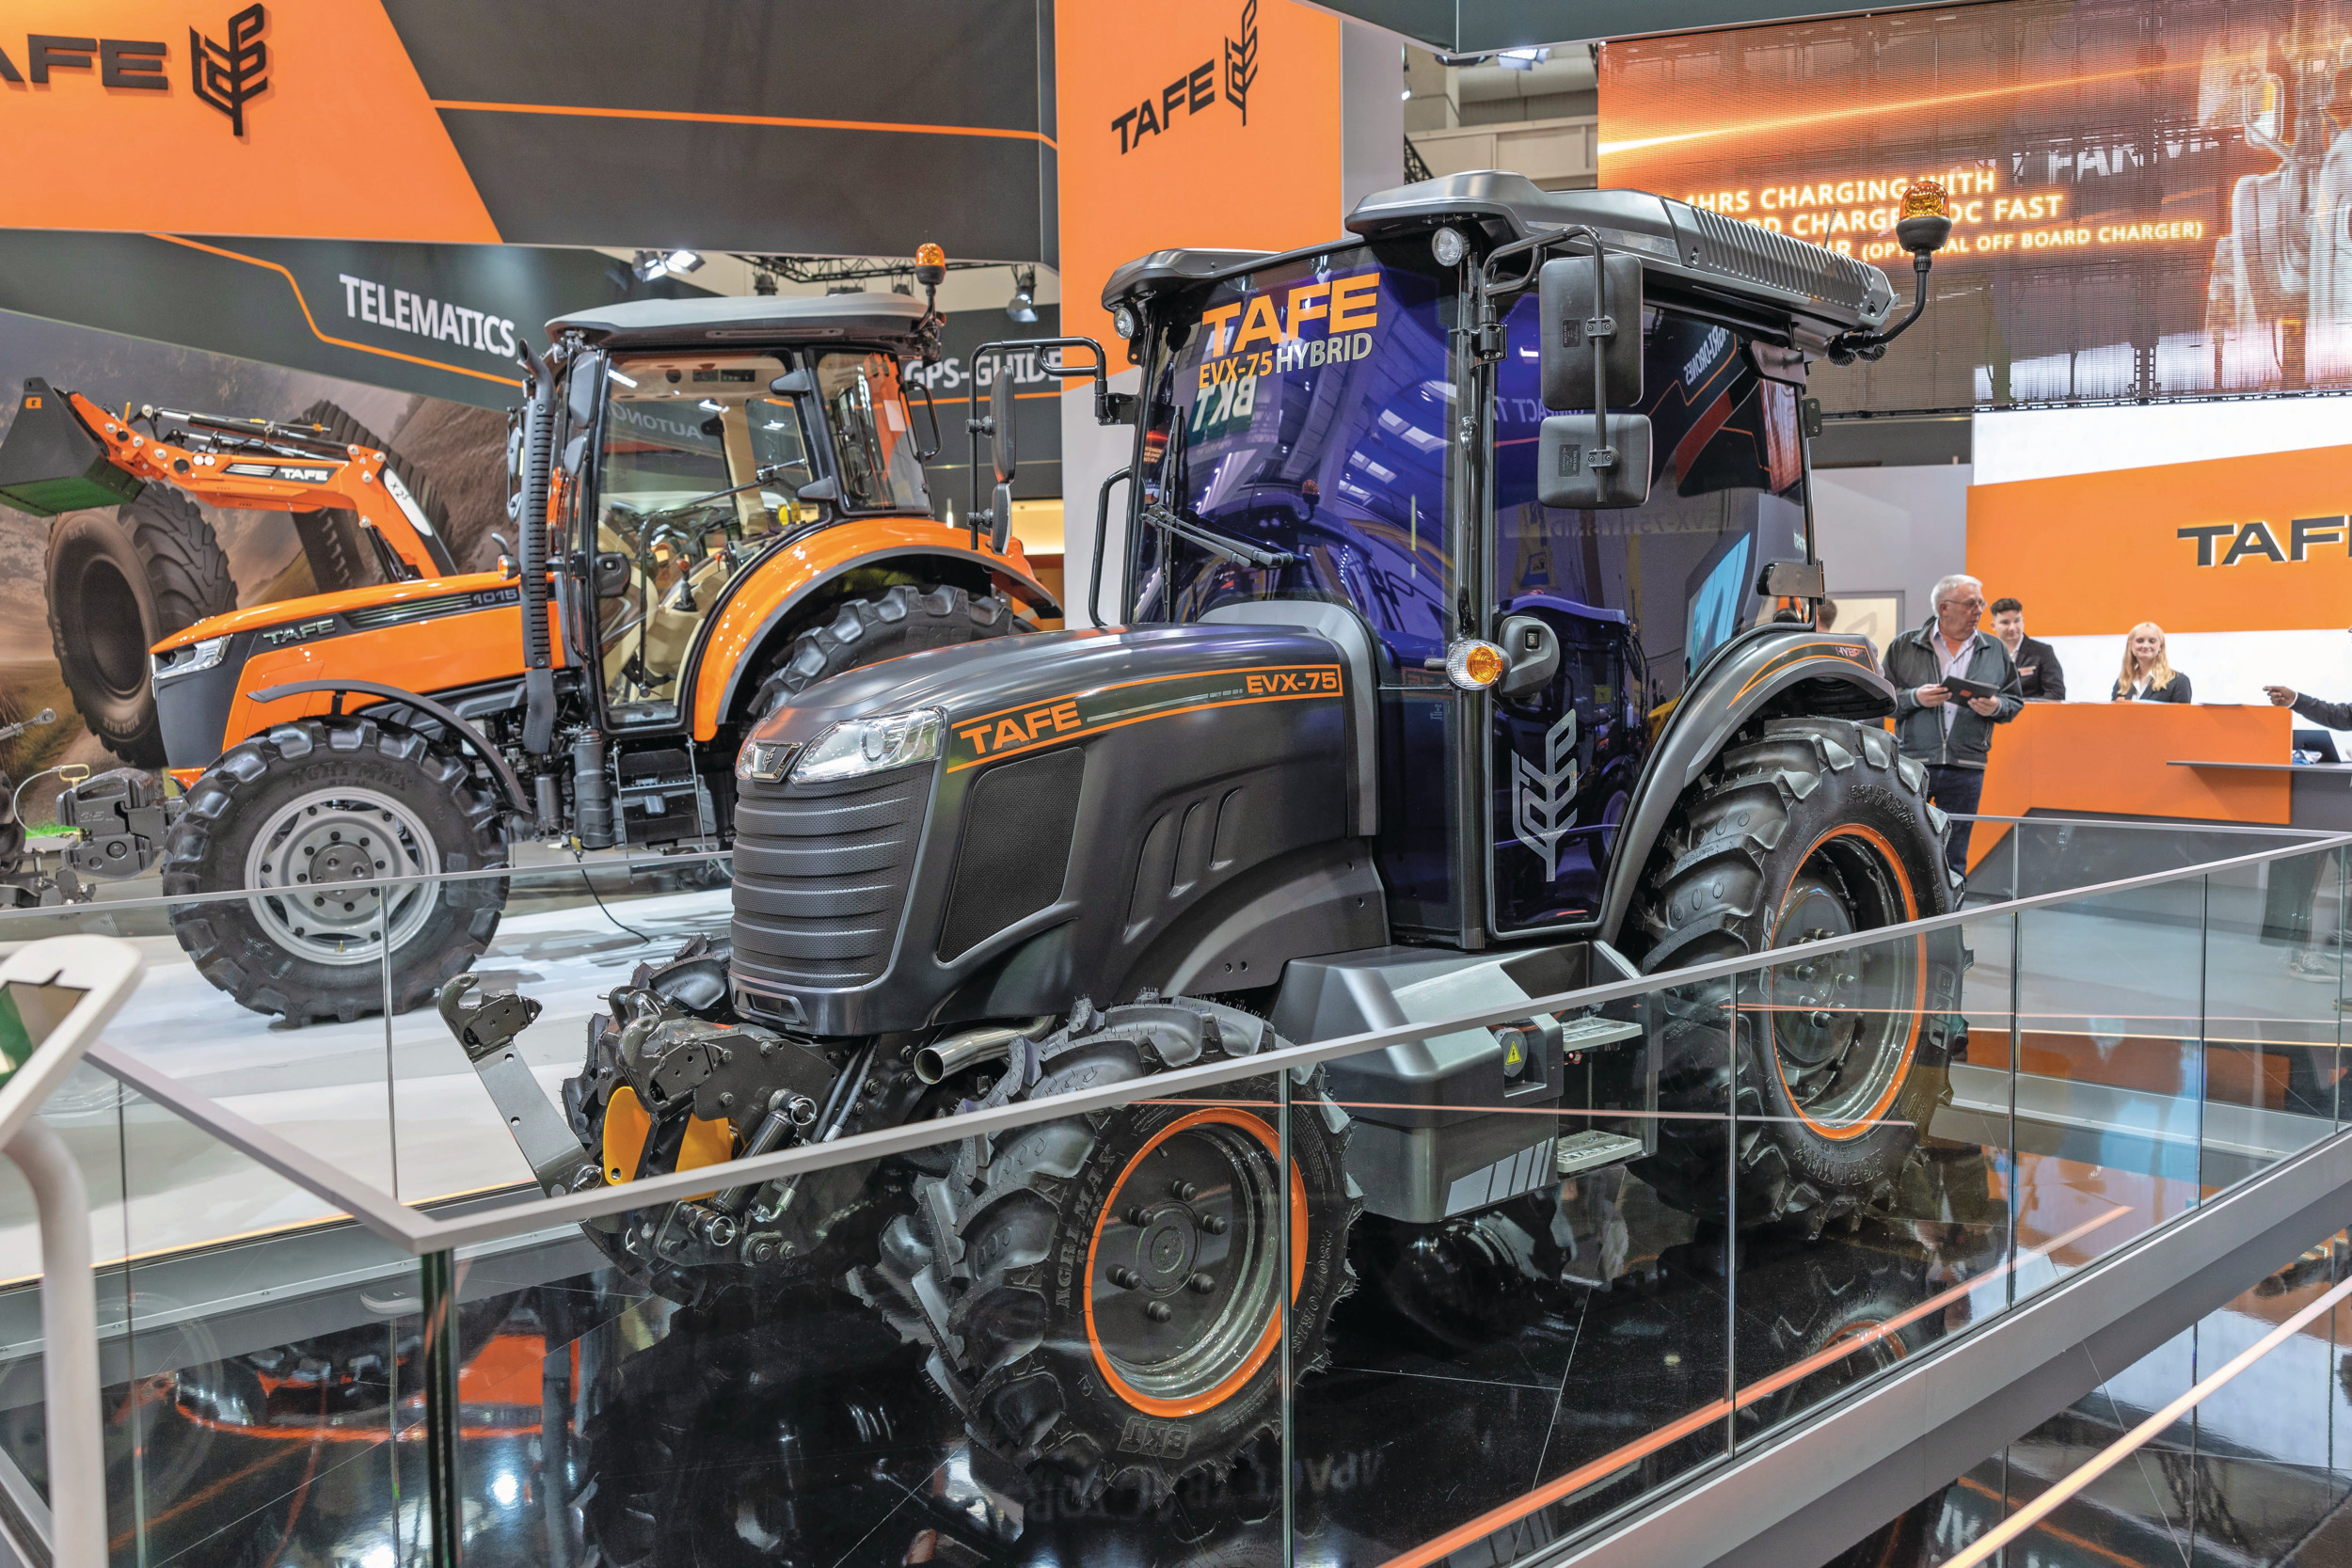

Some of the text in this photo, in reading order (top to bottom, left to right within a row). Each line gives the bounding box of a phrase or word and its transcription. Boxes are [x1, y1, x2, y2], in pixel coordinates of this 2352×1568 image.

[1111, 58, 1216, 155] TAFE
[1761, 179, 1907, 208] CHARGING
[1994, 195, 2063, 220] FAST
[1977, 233, 2013, 250] OFF
[2021, 229, 2090, 248] BOARD
[2098, 222, 2203, 243] CHARGER)
[339, 273, 516, 357] TELEMATICS
[1202, 273, 1380, 358] TAFE
[1276, 333, 1373, 373] HYBRID
[280, 467, 328, 482] TAFE
[2177, 514, 2352, 567] TAF
[262, 619, 335, 645] TAFE
[960, 672, 1338, 754] TAFE EVX-75
